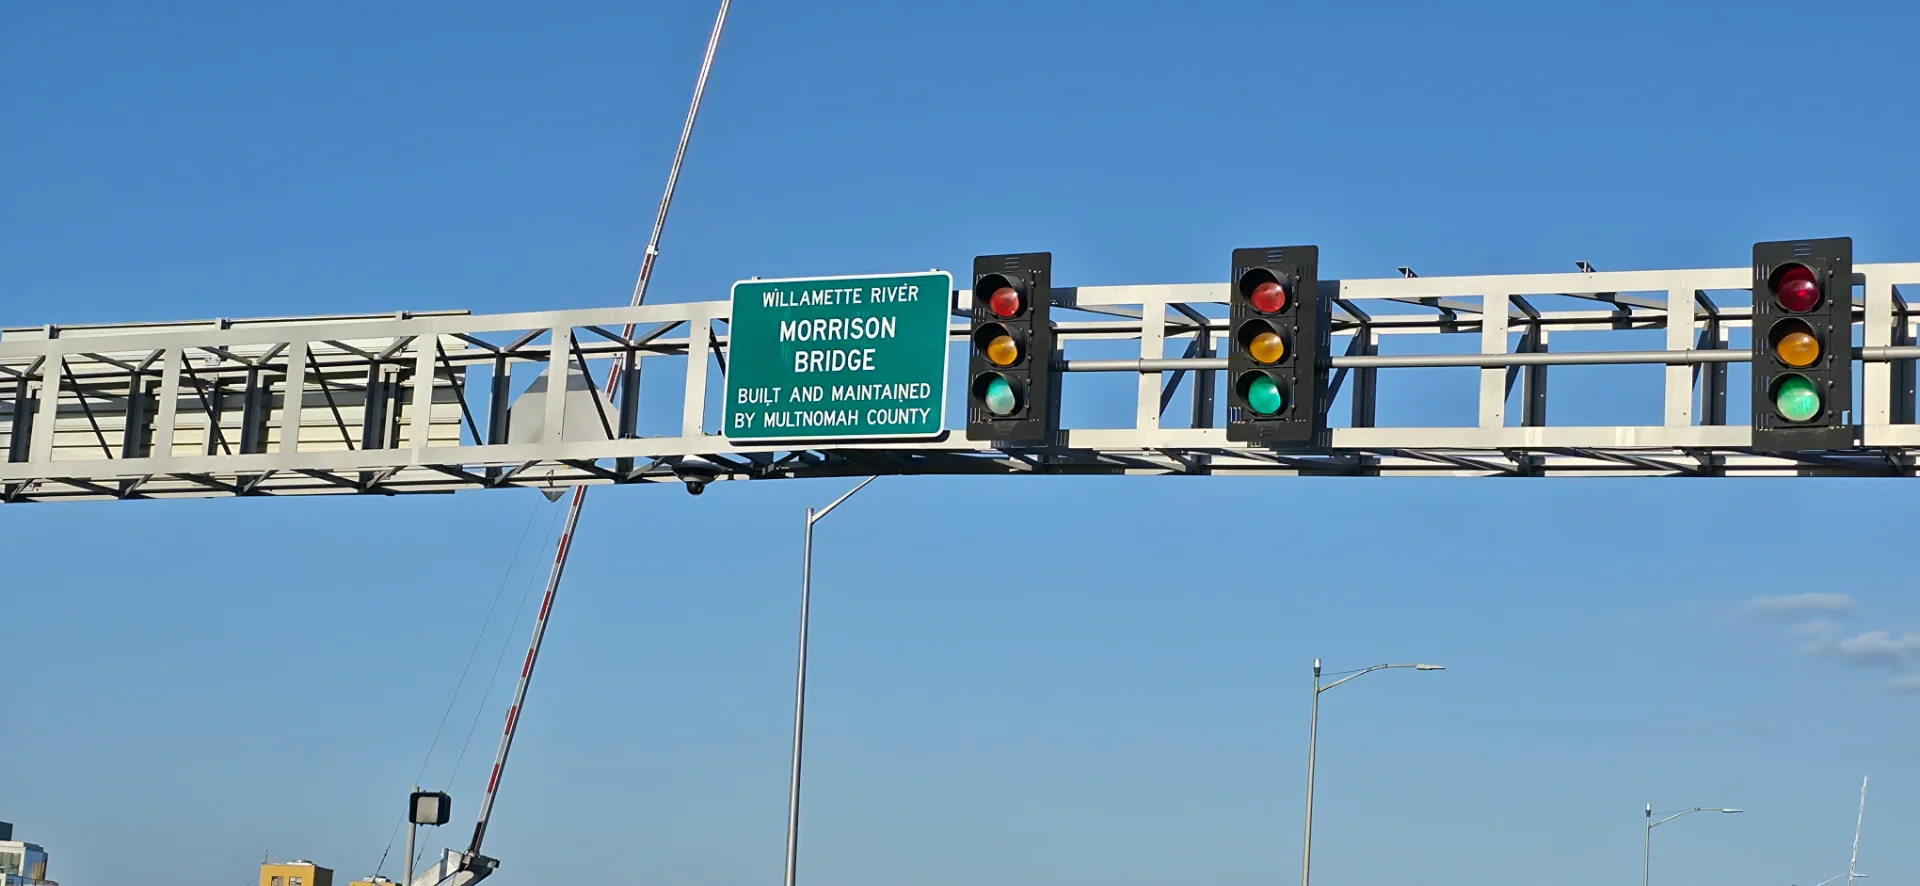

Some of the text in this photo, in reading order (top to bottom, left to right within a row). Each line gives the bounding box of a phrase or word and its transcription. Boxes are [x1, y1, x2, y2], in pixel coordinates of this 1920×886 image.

[762, 285, 919, 307] WILLAMETTE RIVER
[779, 317, 896, 342] MORRISON
[794, 348, 876, 373] BRIDGE
[737, 383, 931, 404] BUILT AND MAINTAINED
[734, 408, 931, 429] BY MULTNOMAH COUNTY
